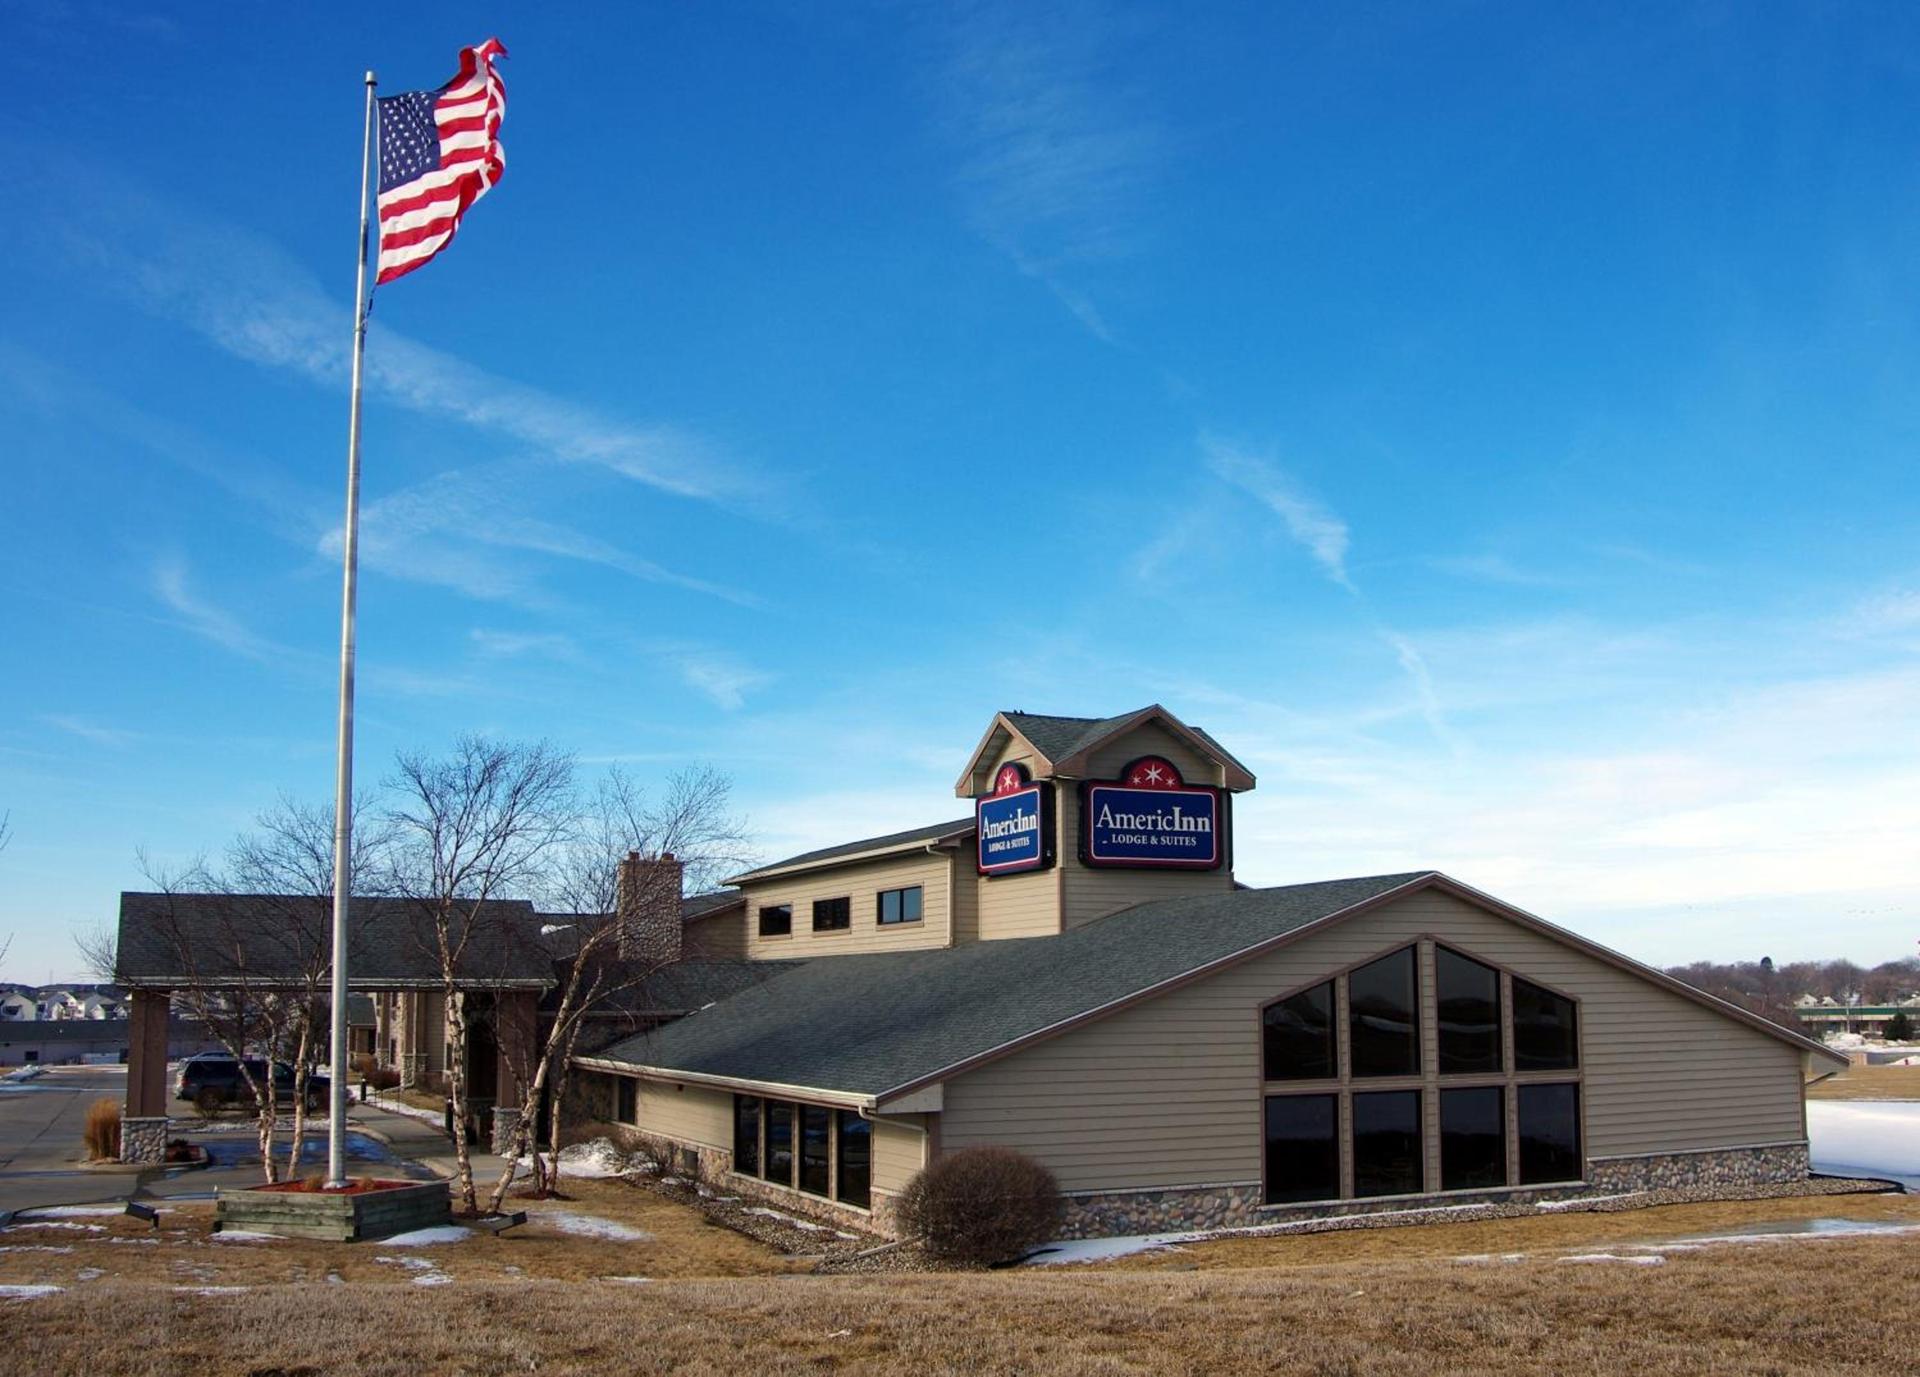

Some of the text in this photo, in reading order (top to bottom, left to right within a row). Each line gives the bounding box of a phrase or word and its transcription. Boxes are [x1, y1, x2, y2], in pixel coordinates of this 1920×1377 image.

[981, 808, 1037, 840] AmericInn
[1096, 803, 1211, 832] AmericInn
[988, 841, 1006, 853] LODGE
[1011, 836, 1030, 848] SUITES
[1111, 834, 1197, 846] LODGE & SUITES
